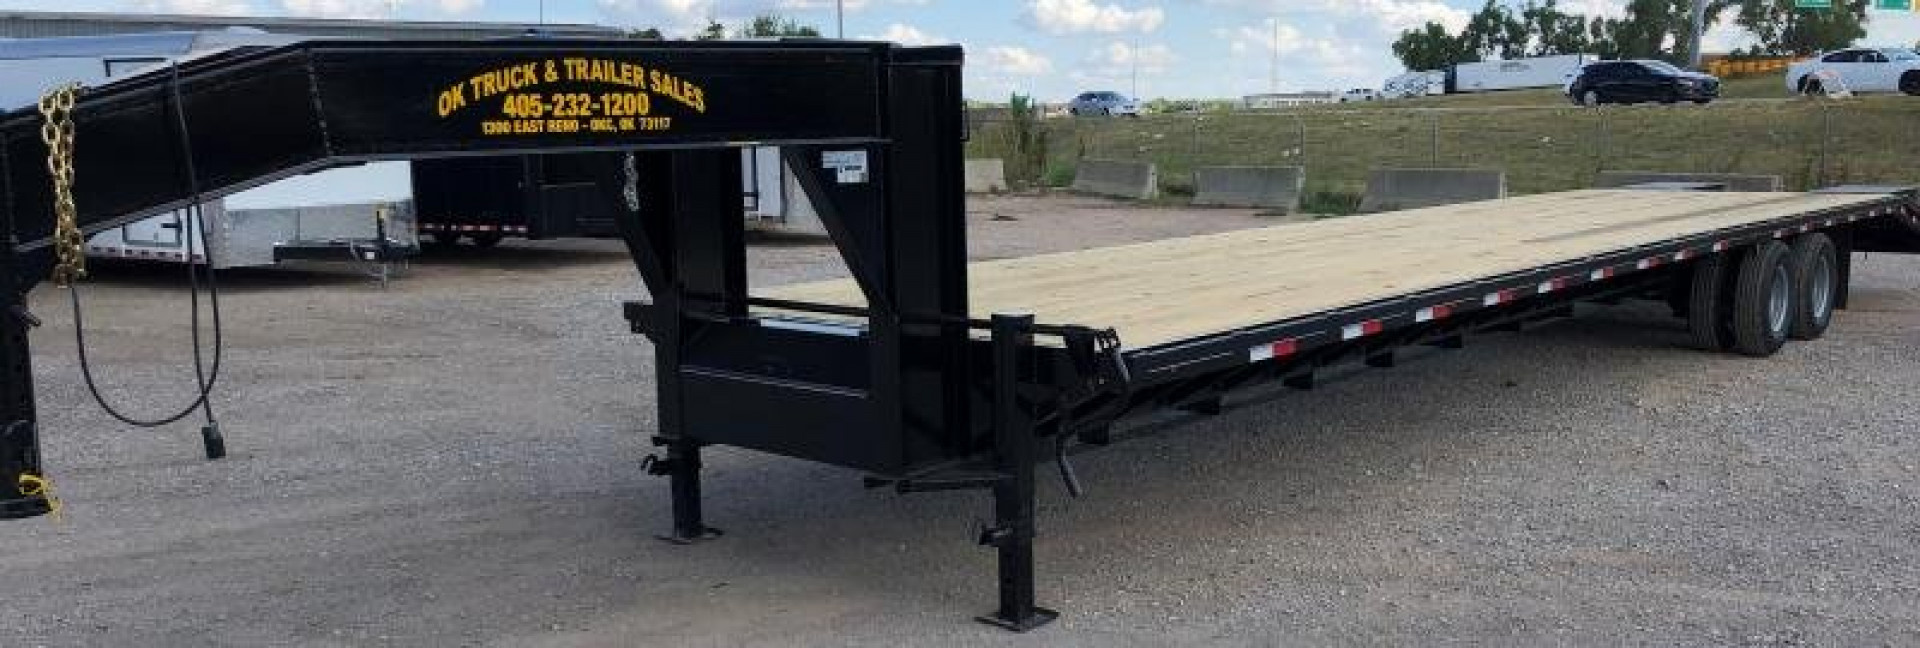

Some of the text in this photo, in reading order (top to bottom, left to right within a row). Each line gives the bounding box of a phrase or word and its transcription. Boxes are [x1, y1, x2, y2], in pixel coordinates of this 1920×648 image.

[438, 57, 706, 117] OK TRUCK & TRAILER SALES
[503, 92, 649, 118] 405-232-1200
[513, 119, 544, 134] EAST
[547, 119, 579, 133] RENO
[619, 118, 636, 131] OK
